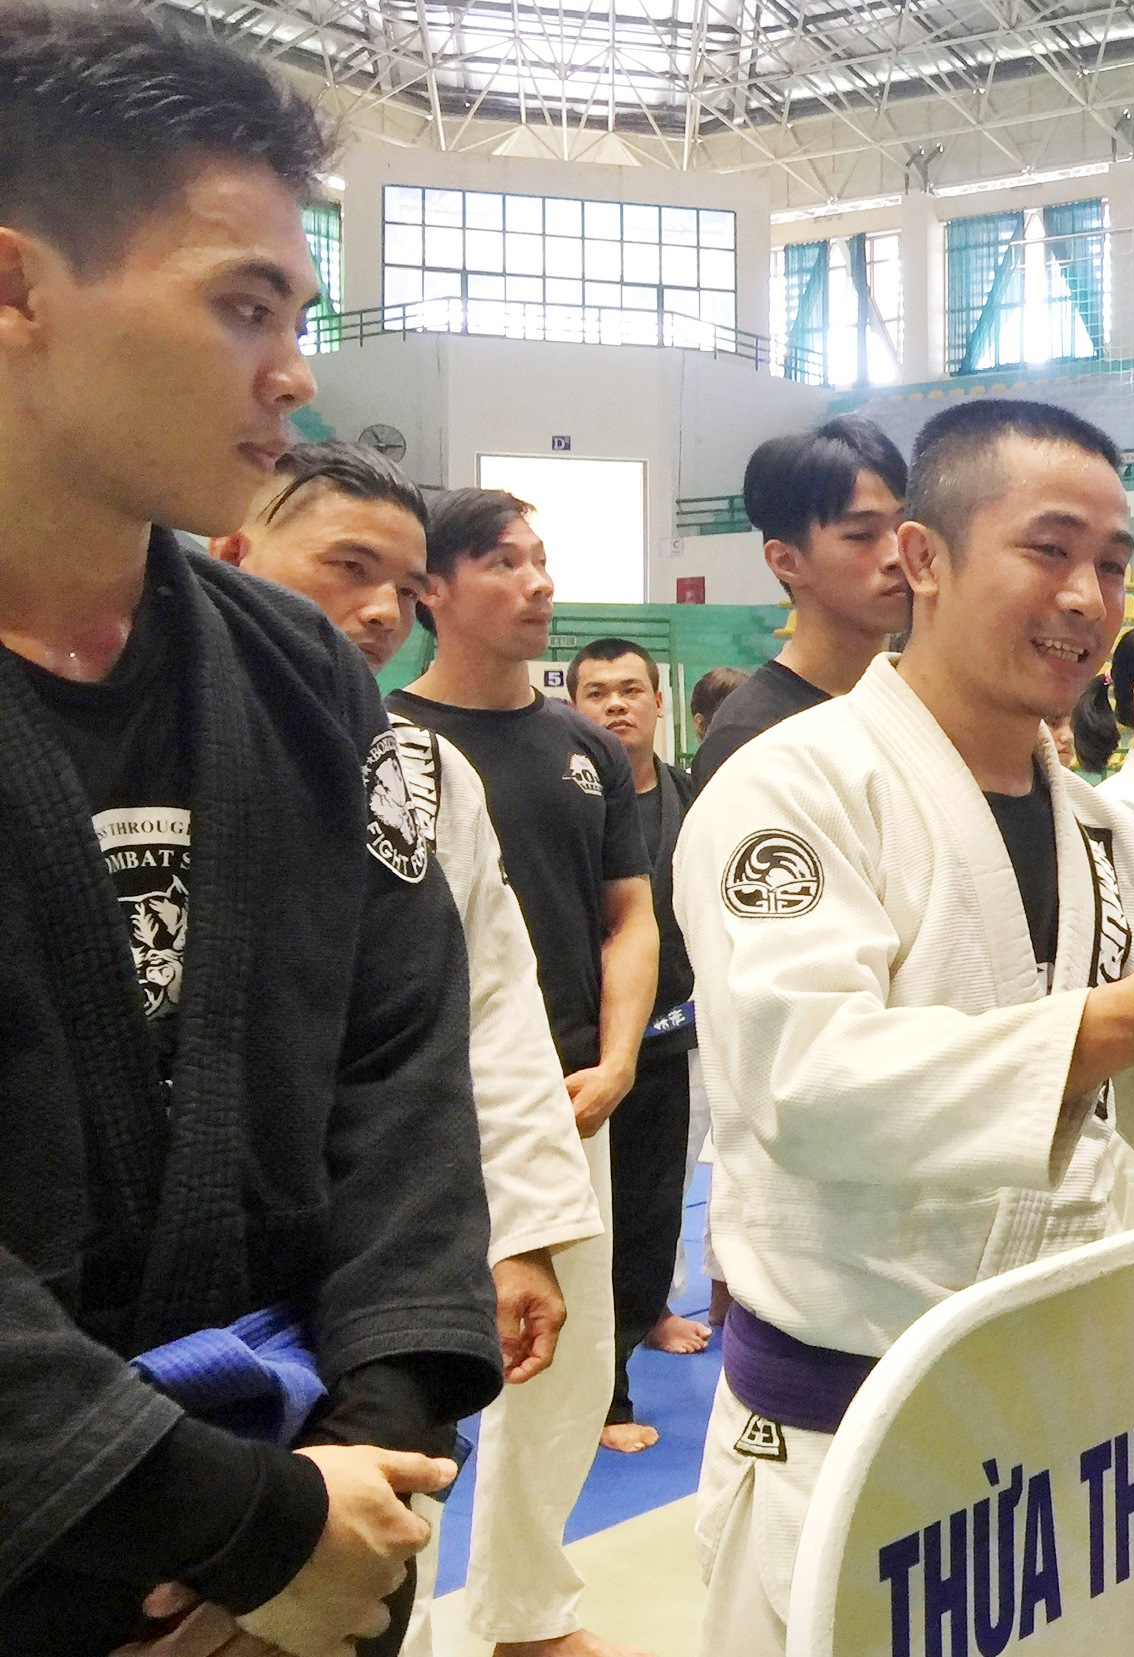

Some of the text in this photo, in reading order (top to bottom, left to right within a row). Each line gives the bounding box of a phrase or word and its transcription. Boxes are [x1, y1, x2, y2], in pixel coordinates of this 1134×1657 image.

[548, 671, 561, 686] 5
[366, 821, 409, 876] FIGHT
[878, 1457, 1063, 1657] THỪA
